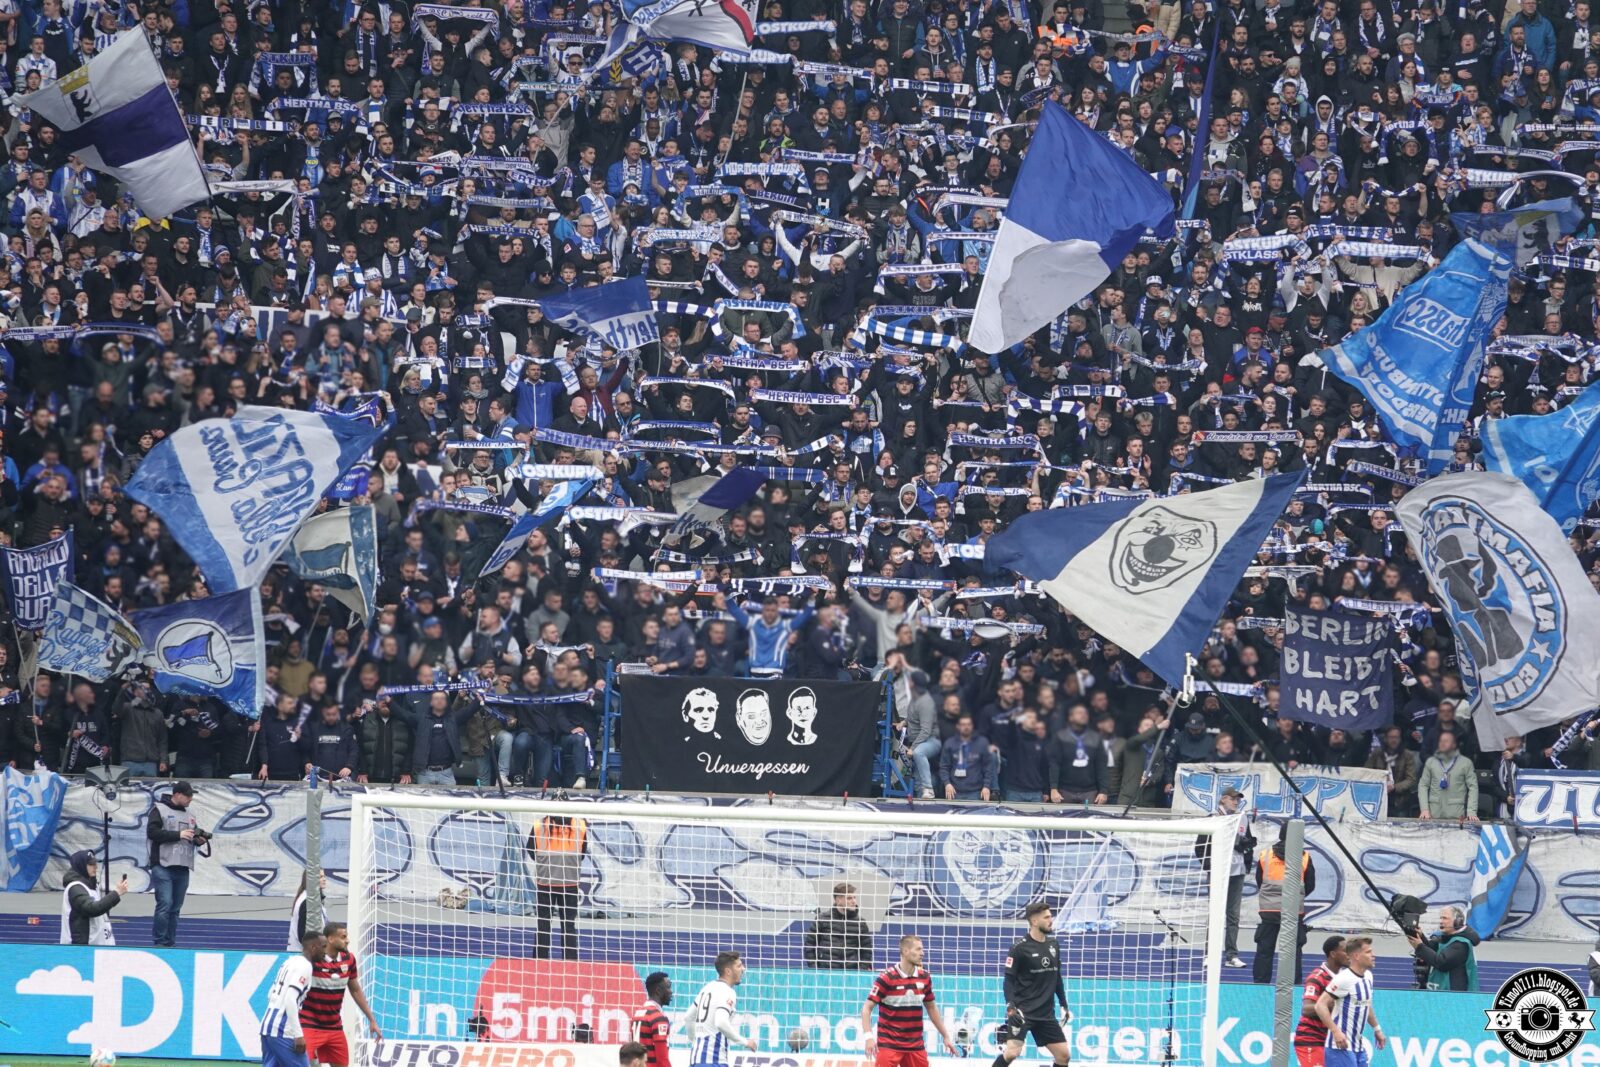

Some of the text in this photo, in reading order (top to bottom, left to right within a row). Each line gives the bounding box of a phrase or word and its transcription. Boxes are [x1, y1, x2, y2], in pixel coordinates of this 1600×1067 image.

[283, 98, 358, 112] HERTHA BSC
[723, 355, 793, 370] HERTHA BSC
[768, 389, 841, 404] HERTHA BSC
[958, 433, 1033, 445] HERTHA BSC
[1305, 483, 1361, 492] HERTHA BSC
[571, 506, 625, 520] OSTKU
[1285, 607, 1390, 646] BERLIN
[1283, 646, 1388, 682] BLEIBT
[1295, 685, 1381, 718] HART
[697, 751, 810, 780] Unvergessen
[93, 949, 280, 1058] DK
[409, 989, 458, 1037] In
[492, 991, 631, 1043] 5min
[696, 991, 712, 1023] 19
[371, 1043, 576, 1067] UTOHERO
